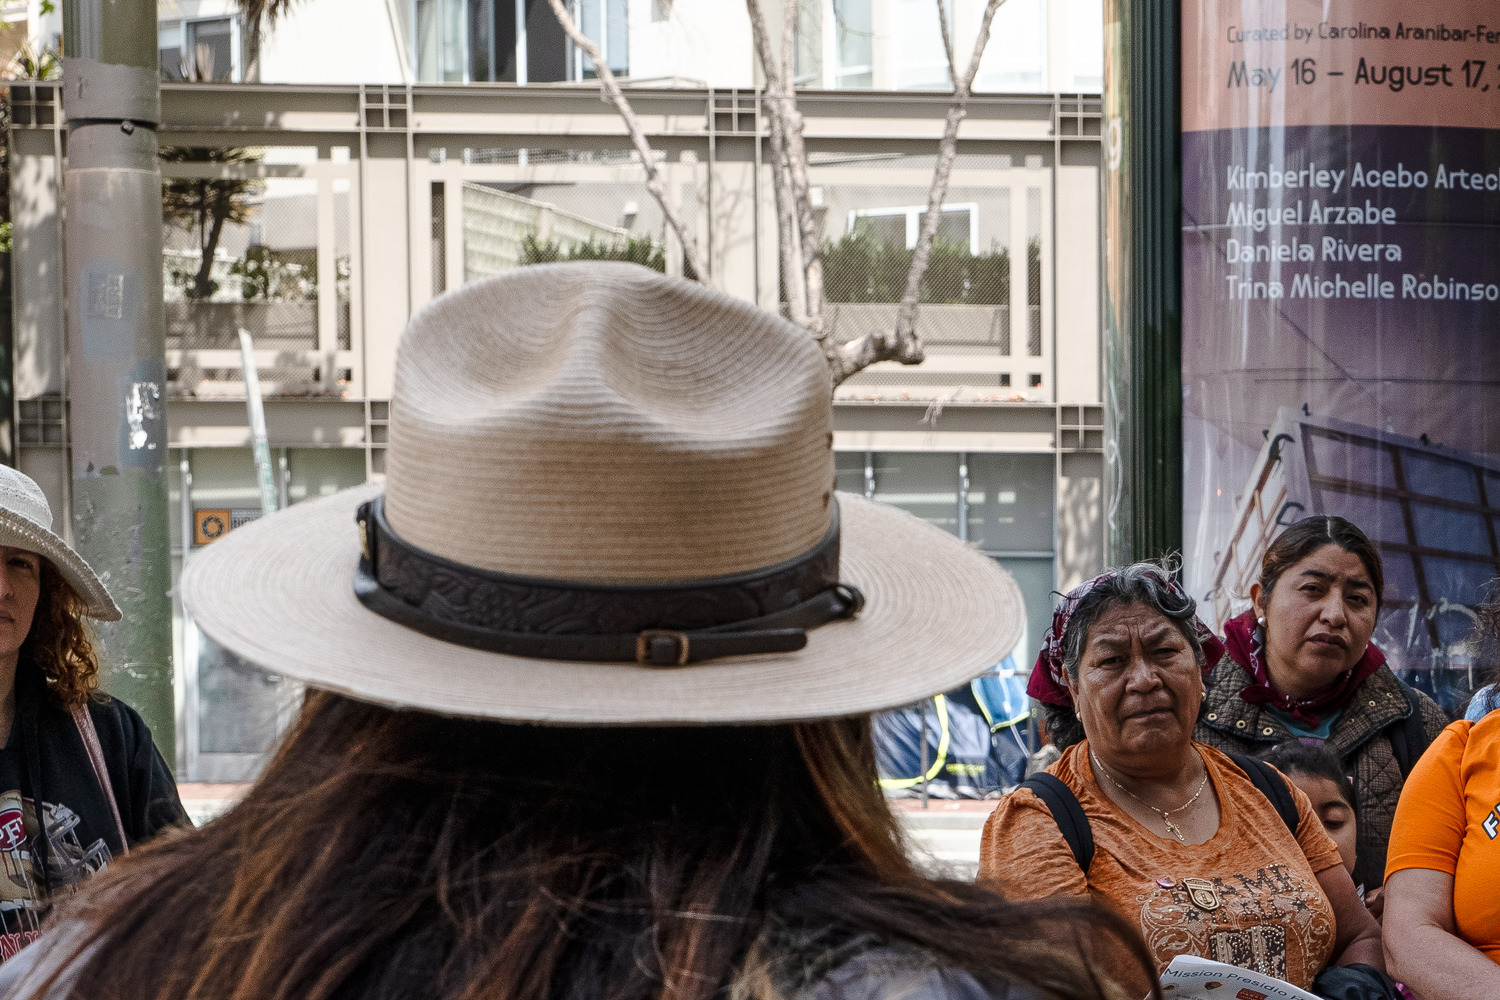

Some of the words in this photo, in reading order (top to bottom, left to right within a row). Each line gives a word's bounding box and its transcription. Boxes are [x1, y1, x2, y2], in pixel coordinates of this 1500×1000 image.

[1227, 22, 1289, 43] Curated
[1294, 23, 1313, 44] by
[1318, 22, 1390, 39] Carolina
[1227, 60, 1281, 94] May
[1291, 57, 1316, 85] 16
[1355, 56, 1453, 92] August
[1461, 59, 1490, 92] 17,
[1226, 162, 1345, 194] Kimberley
[1351, 162, 1428, 189] Acebo
[1226, 200, 1302, 232] Miguel
[1308, 199, 1396, 225] Arzabe
[1226, 236, 1315, 264] Daniela
[1321, 235, 1402, 262] Rivera
[1226, 274, 1284, 300] Trina
[1290, 272, 1395, 299] Michelle
[1164, 968, 1223, 978] Mission
[1226, 973, 1288, 997] Presidio
